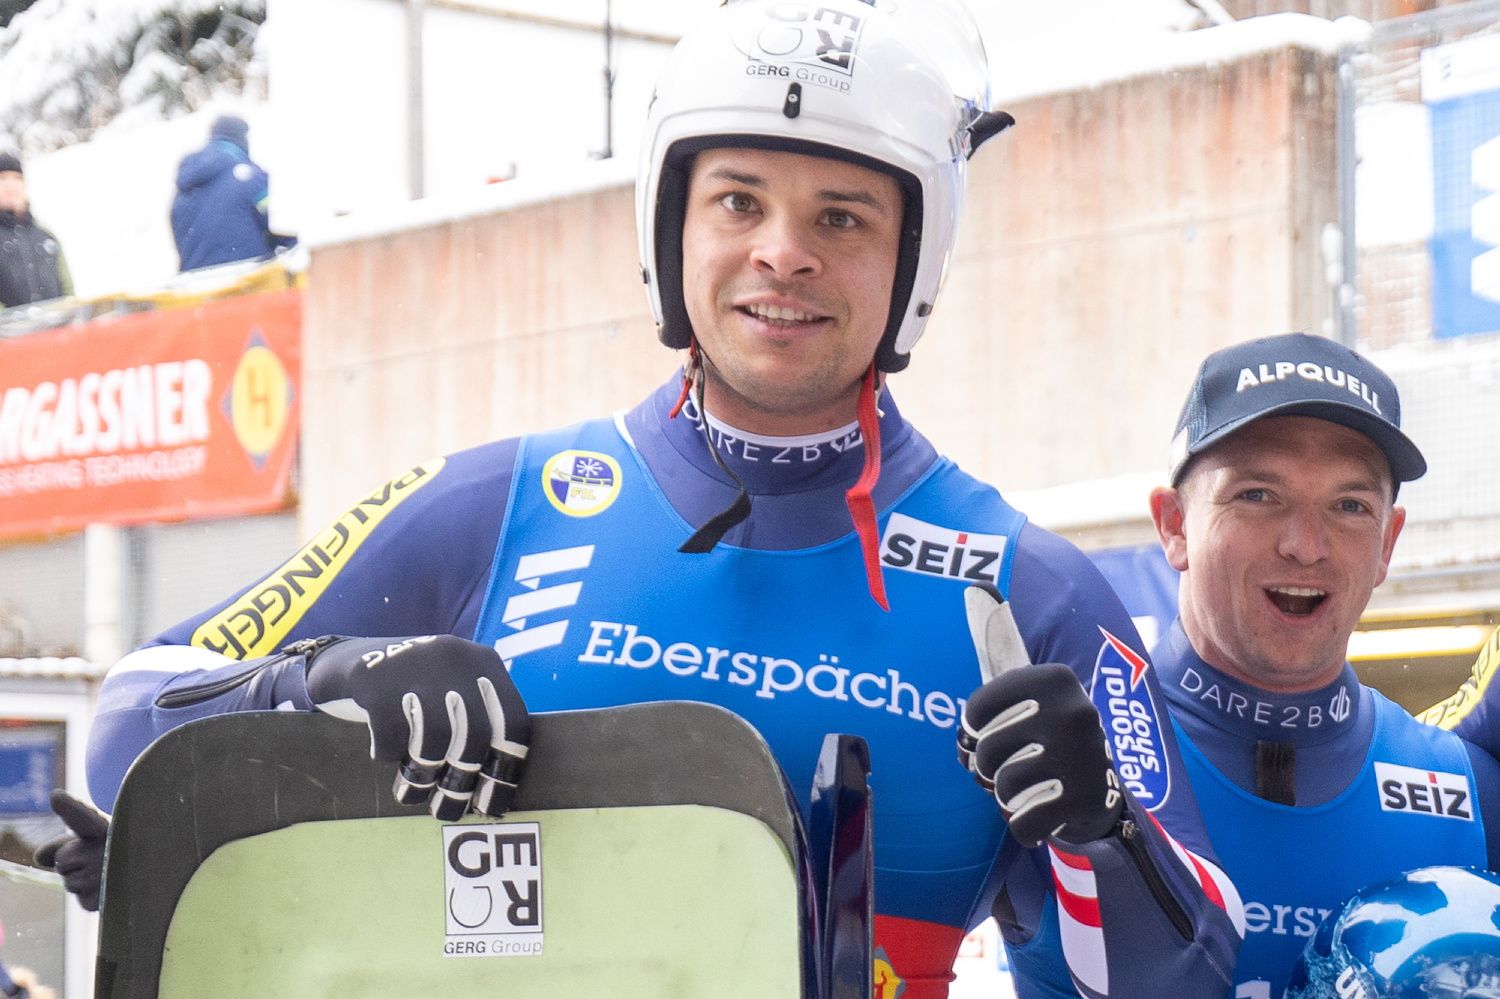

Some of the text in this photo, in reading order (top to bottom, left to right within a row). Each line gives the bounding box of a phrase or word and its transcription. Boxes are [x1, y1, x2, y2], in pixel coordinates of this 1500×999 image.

[746, 64, 850, 93] GERG Group
[1236, 362, 1382, 415] ALPQUELL
[1101, 666, 1154, 799] personal
[1129, 699, 1161, 774] shop
[444, 939, 542, 957] GERG Group
